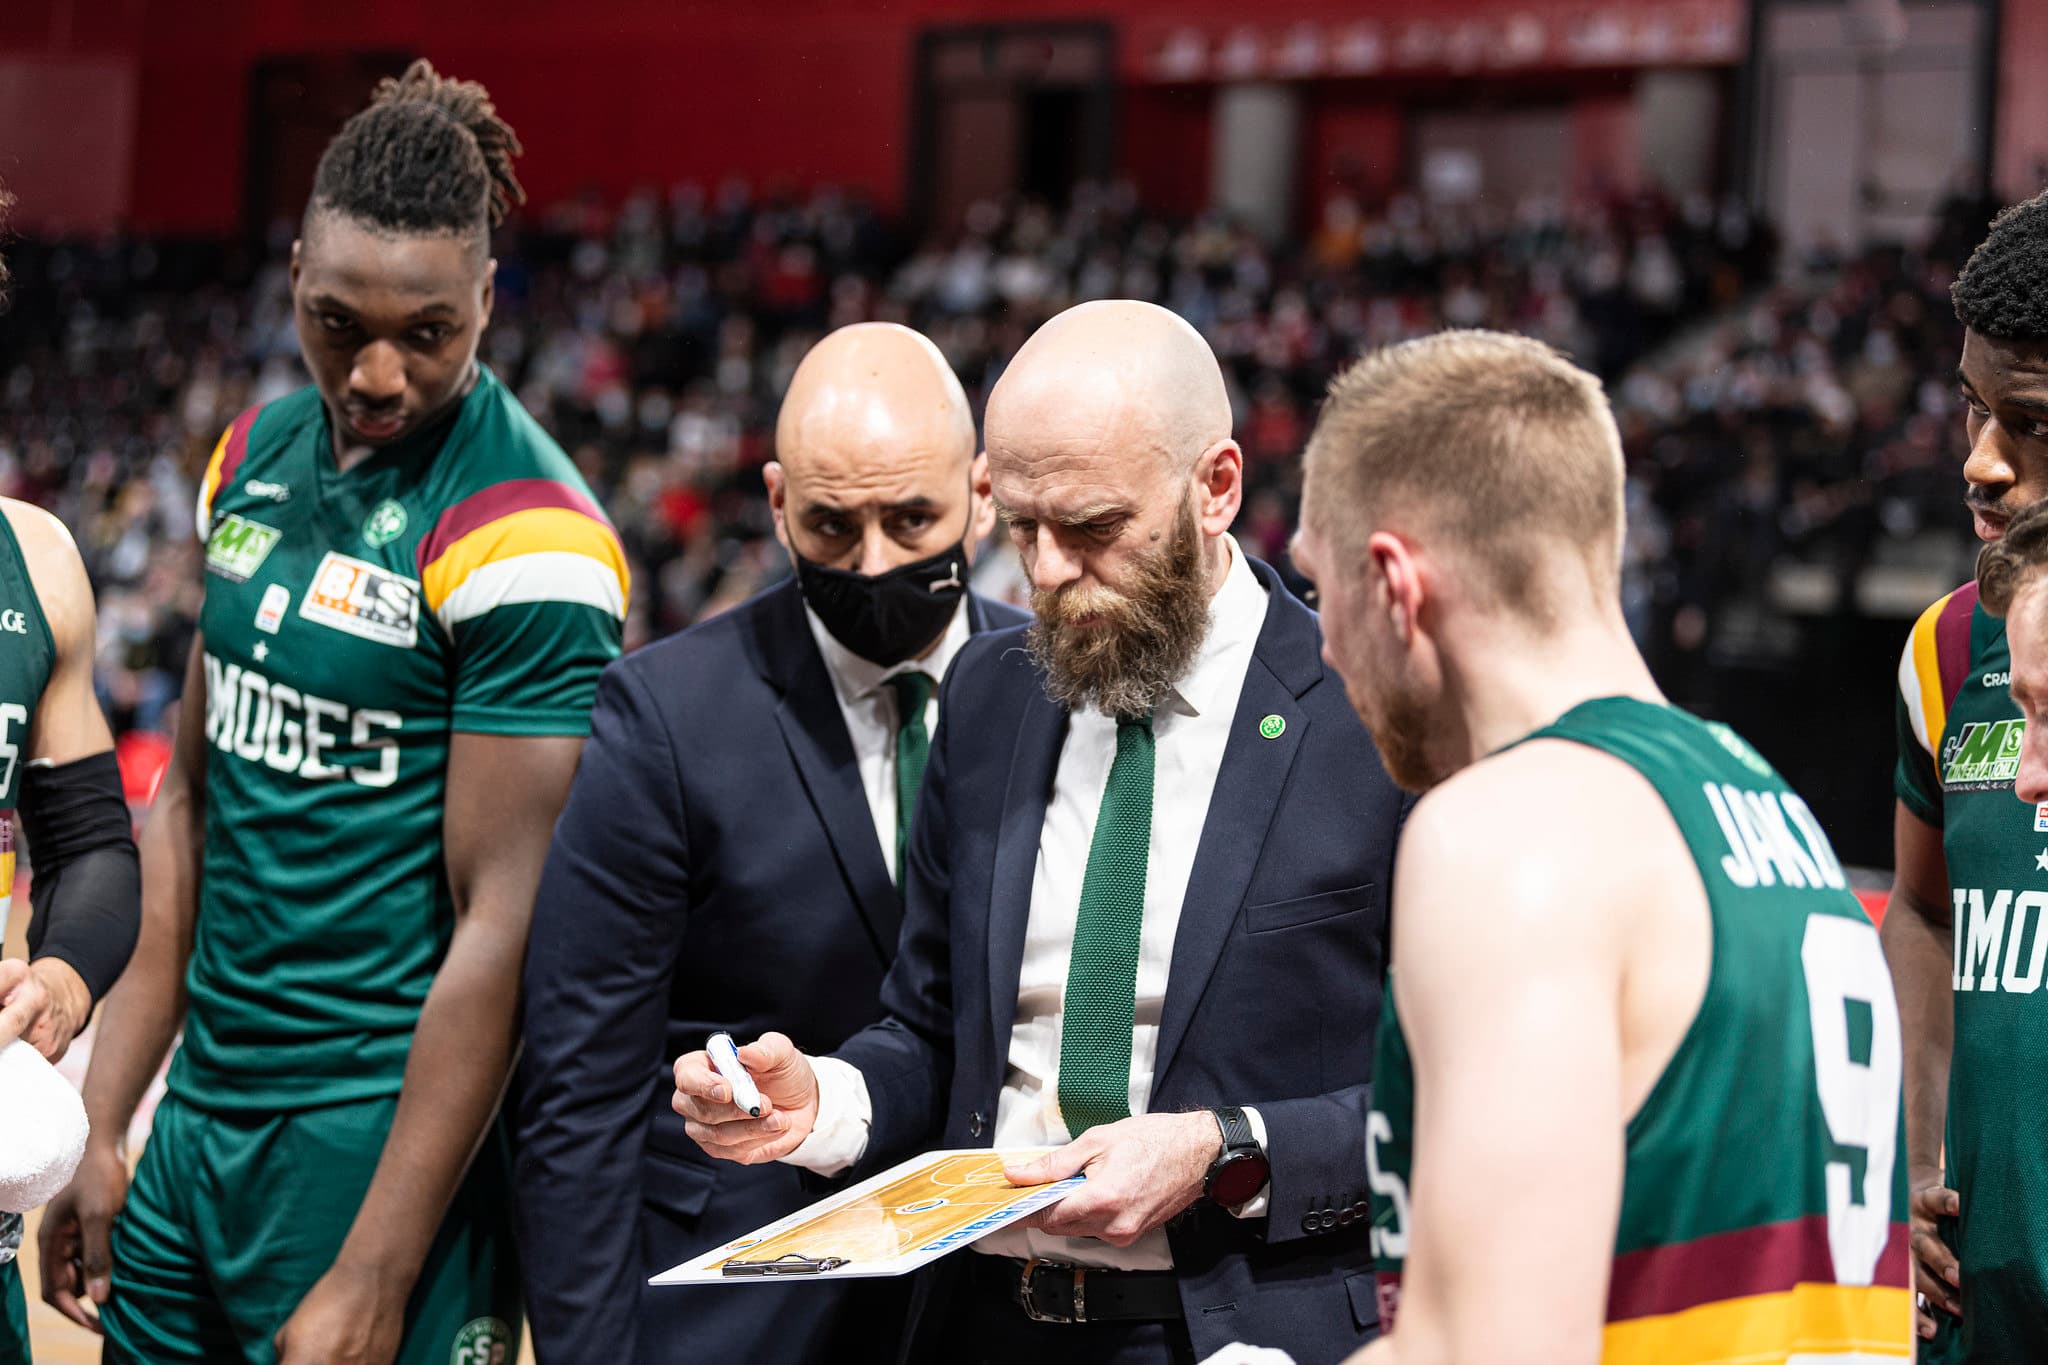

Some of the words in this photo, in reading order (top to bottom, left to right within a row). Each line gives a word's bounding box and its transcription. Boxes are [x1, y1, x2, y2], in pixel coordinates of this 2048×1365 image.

[317, 561, 410, 618] BLS
[0, 608, 27, 635] GE
[1982, 672, 2012, 687] CRA
[1952, 888, 2048, 994] IMO
[1801, 912, 1902, 1287] 9
